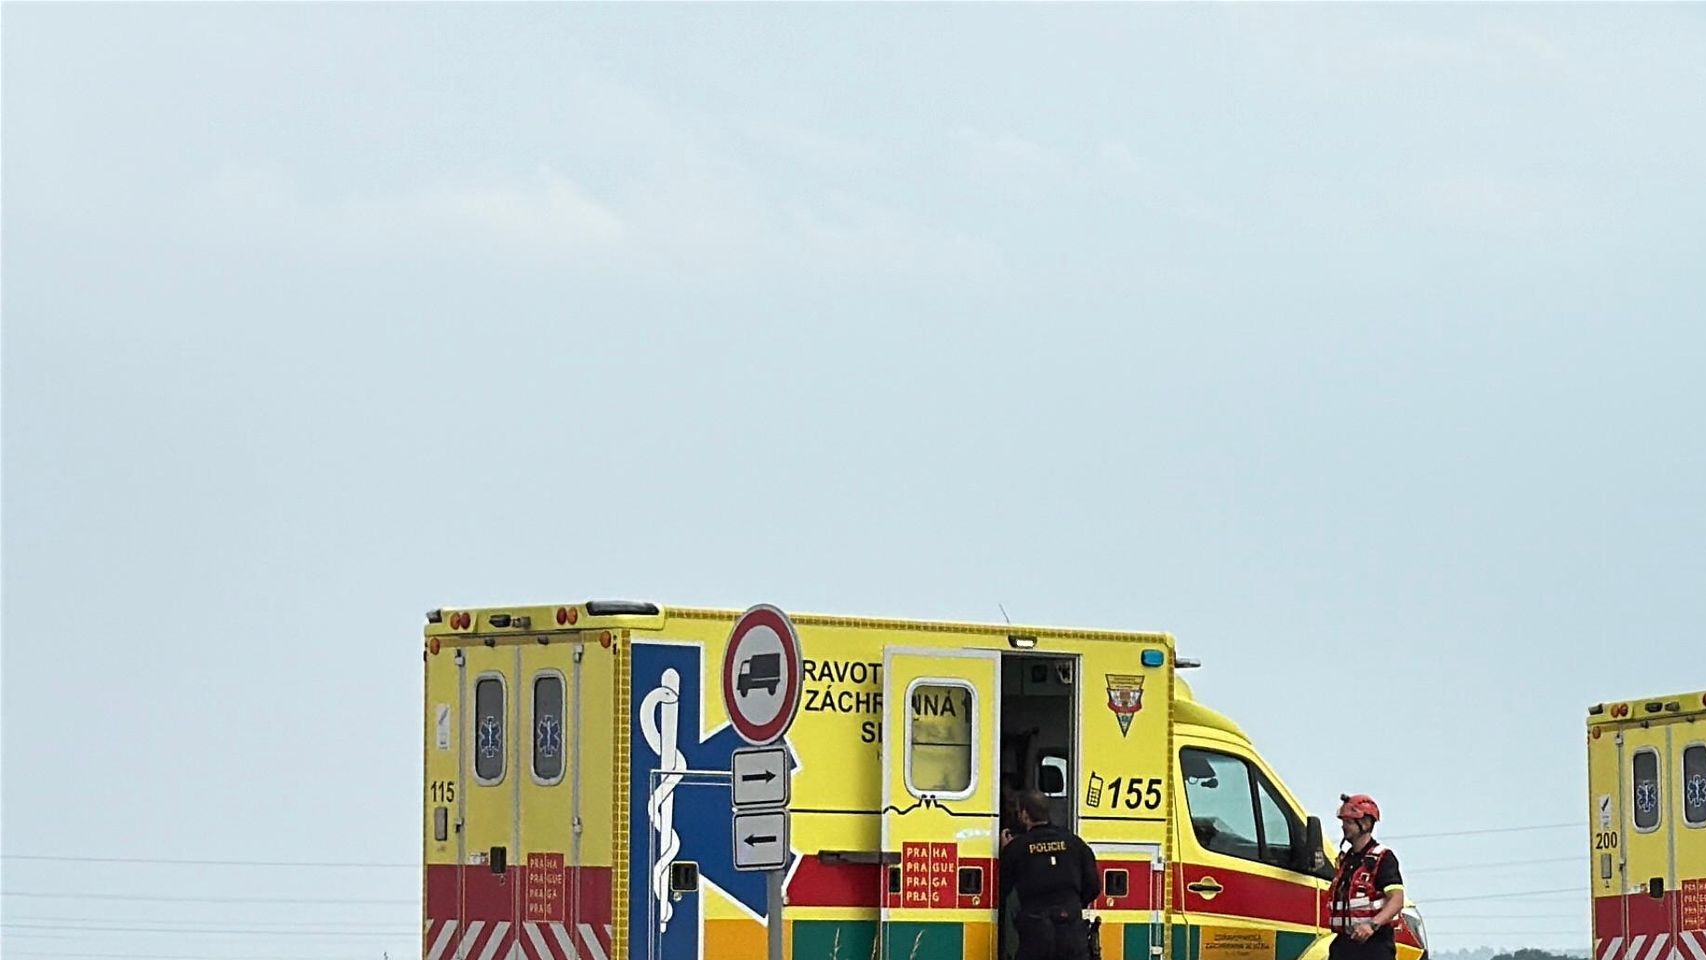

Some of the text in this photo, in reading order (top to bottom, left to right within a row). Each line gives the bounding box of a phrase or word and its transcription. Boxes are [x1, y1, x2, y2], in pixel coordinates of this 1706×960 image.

[430, 781, 456, 803] 115
[1107, 776, 1163, 810] 155
[1028, 840, 1068, 854] POLICIE
[1595, 831, 1618, 850] 200
